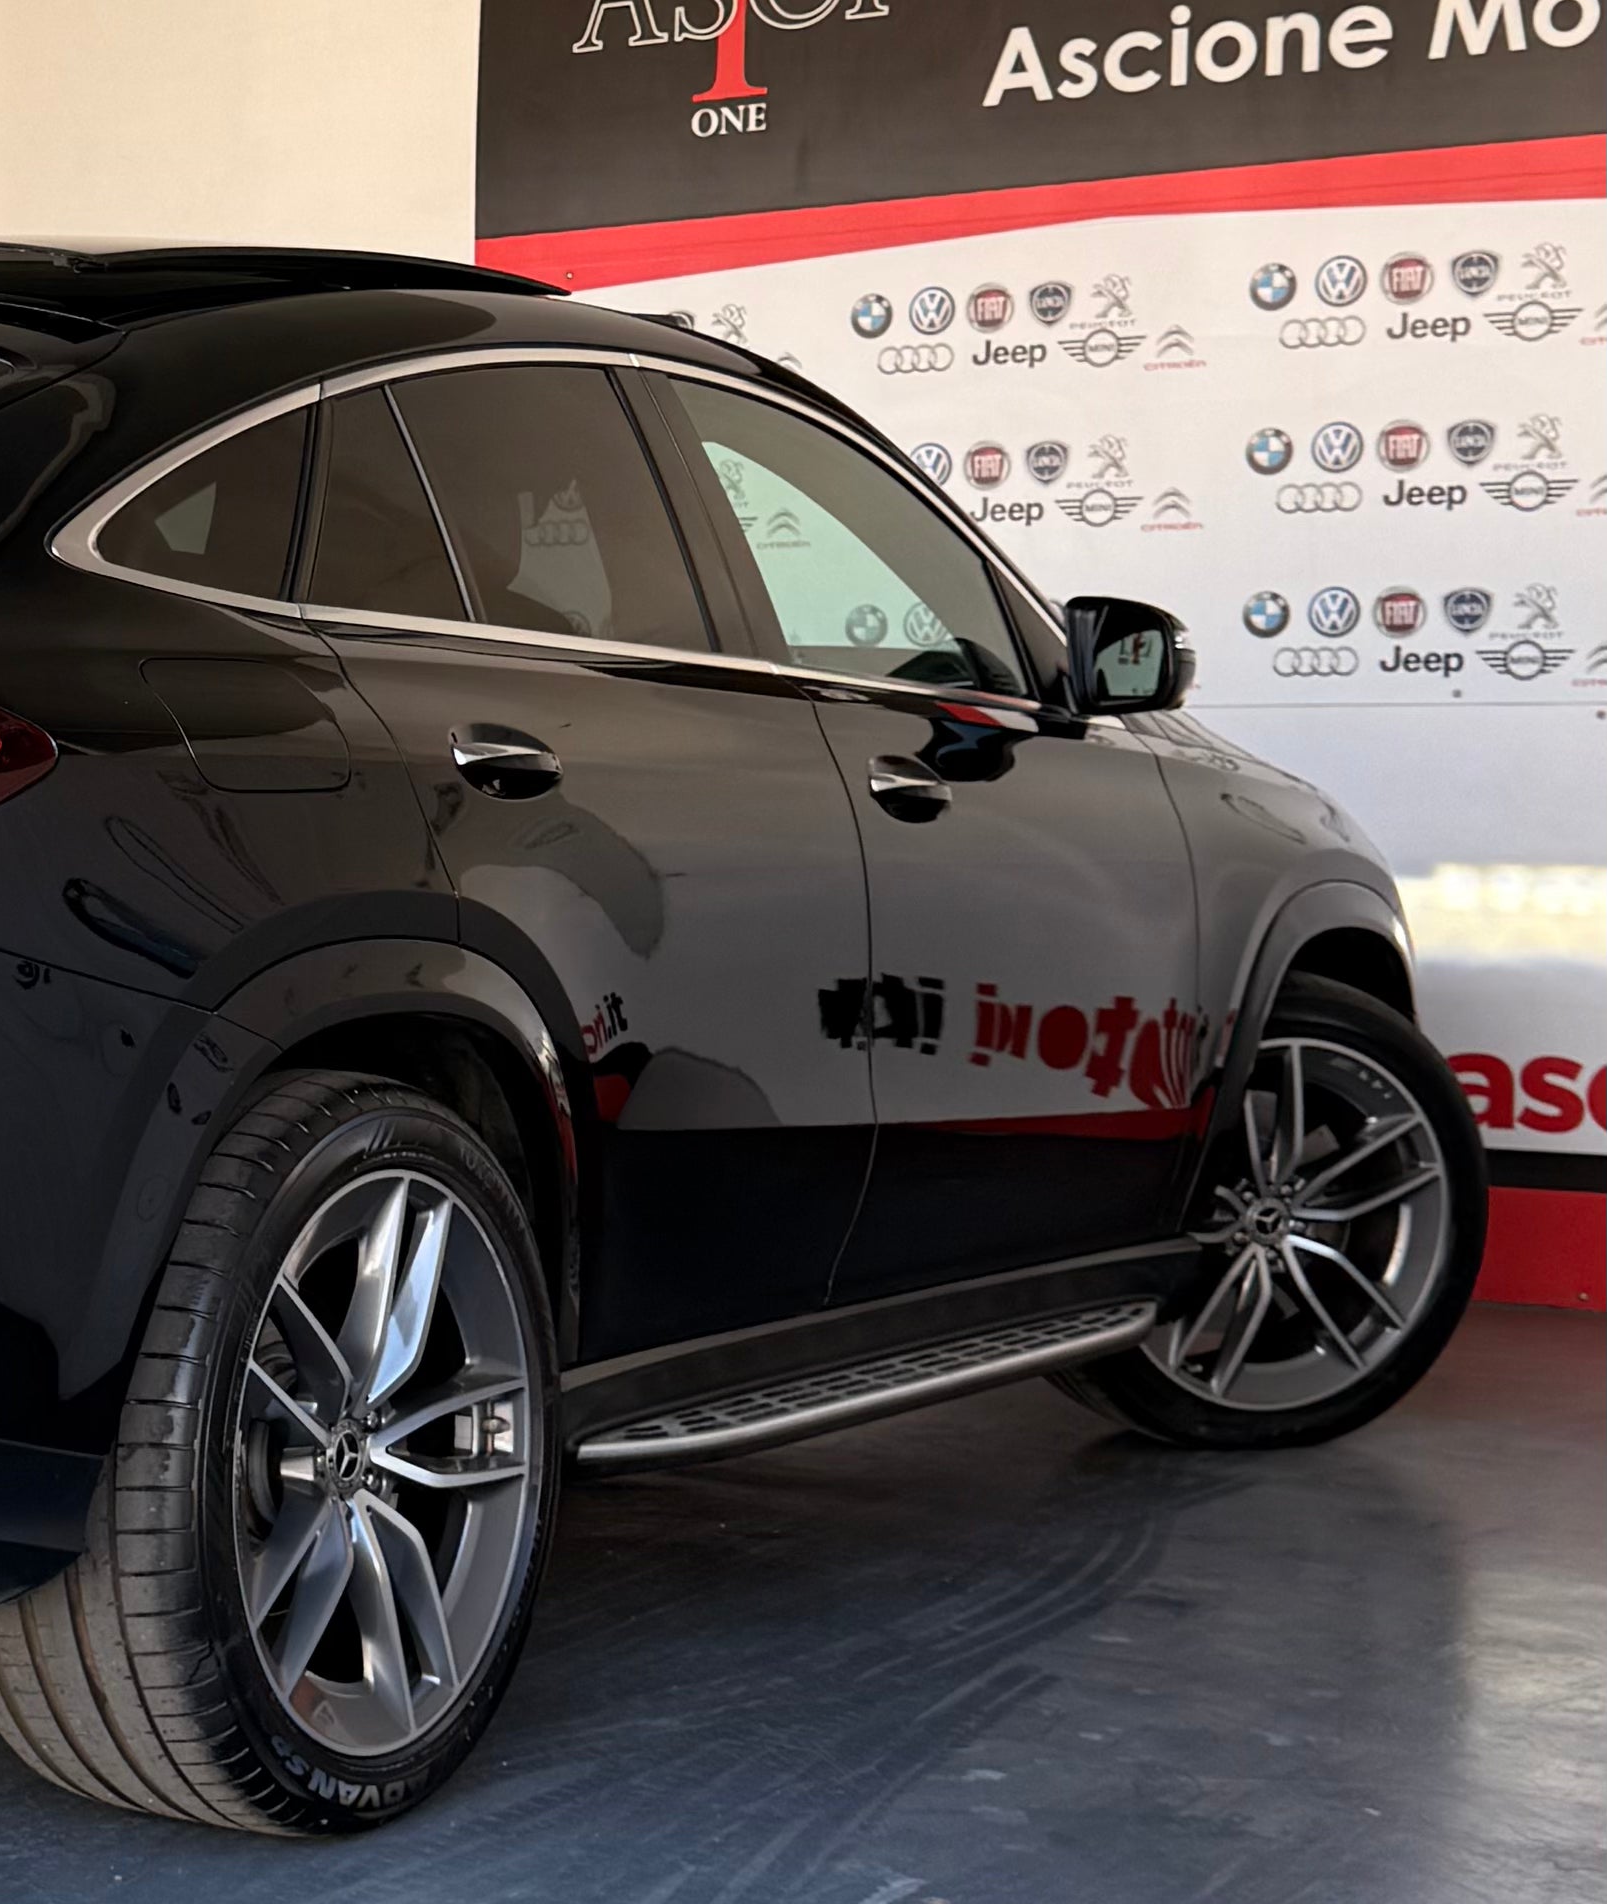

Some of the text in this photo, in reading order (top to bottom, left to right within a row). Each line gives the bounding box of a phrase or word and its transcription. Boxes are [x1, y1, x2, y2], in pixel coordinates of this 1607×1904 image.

[982, 2, 1393, 107] Ascione
[691, 102, 768, 137] ONE
[1386, 312, 1471, 342] Jeep
[972, 340, 1047, 368] Jeep
[974, 455, 1002, 479] FIAT
[1383, 479, 1467, 510] Jeep
[970, 497, 1044, 526] Jeep
[1380, 645, 1464, 677] Jeep
